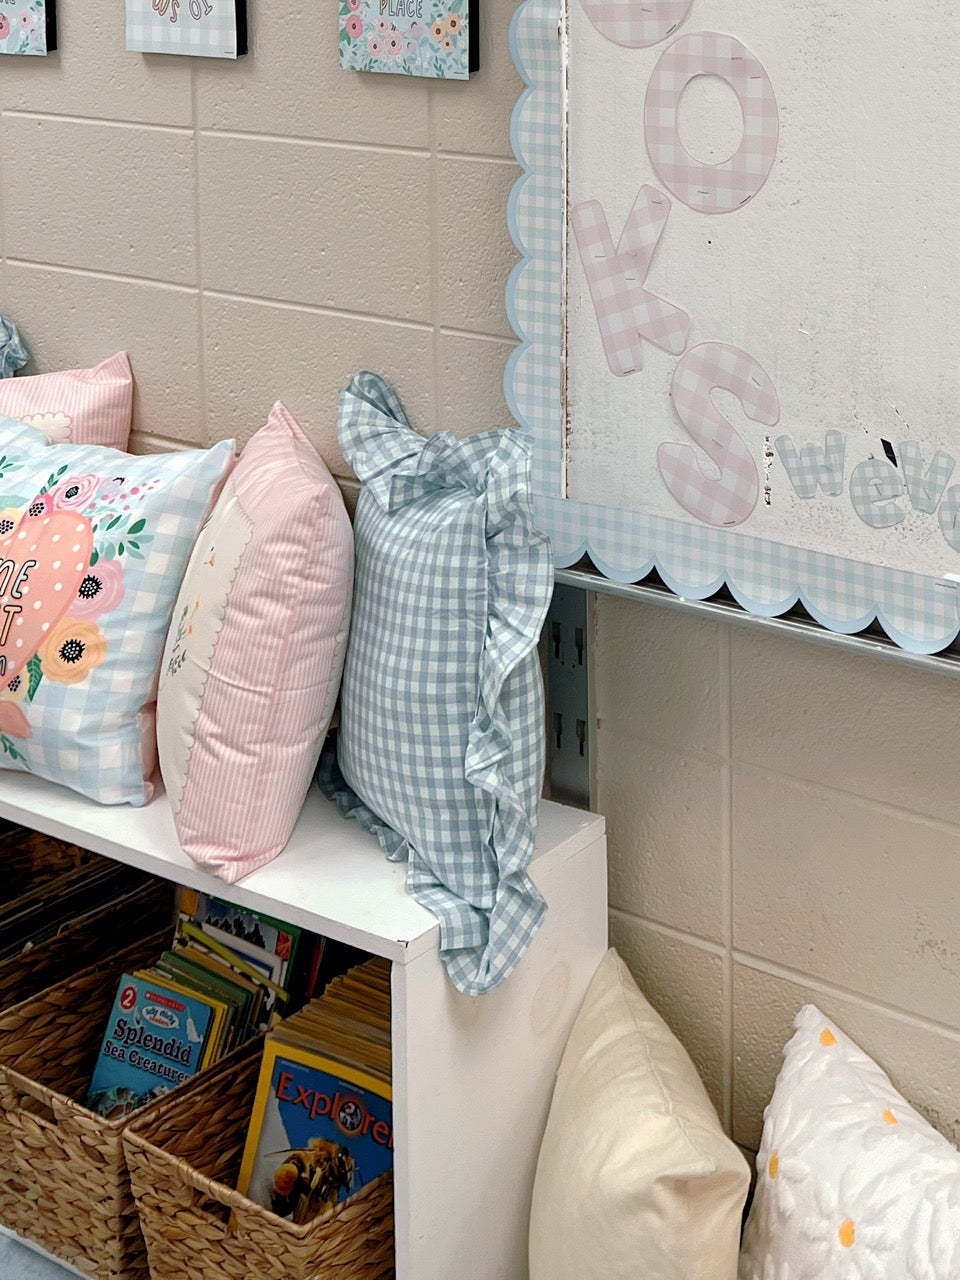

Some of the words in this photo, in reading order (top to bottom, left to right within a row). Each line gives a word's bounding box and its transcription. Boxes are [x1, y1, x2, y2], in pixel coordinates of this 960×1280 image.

[122, 989, 134, 1007] 2
[104, 1040, 126, 1061] Sea
[114, 1018, 192, 1065] Splendid
